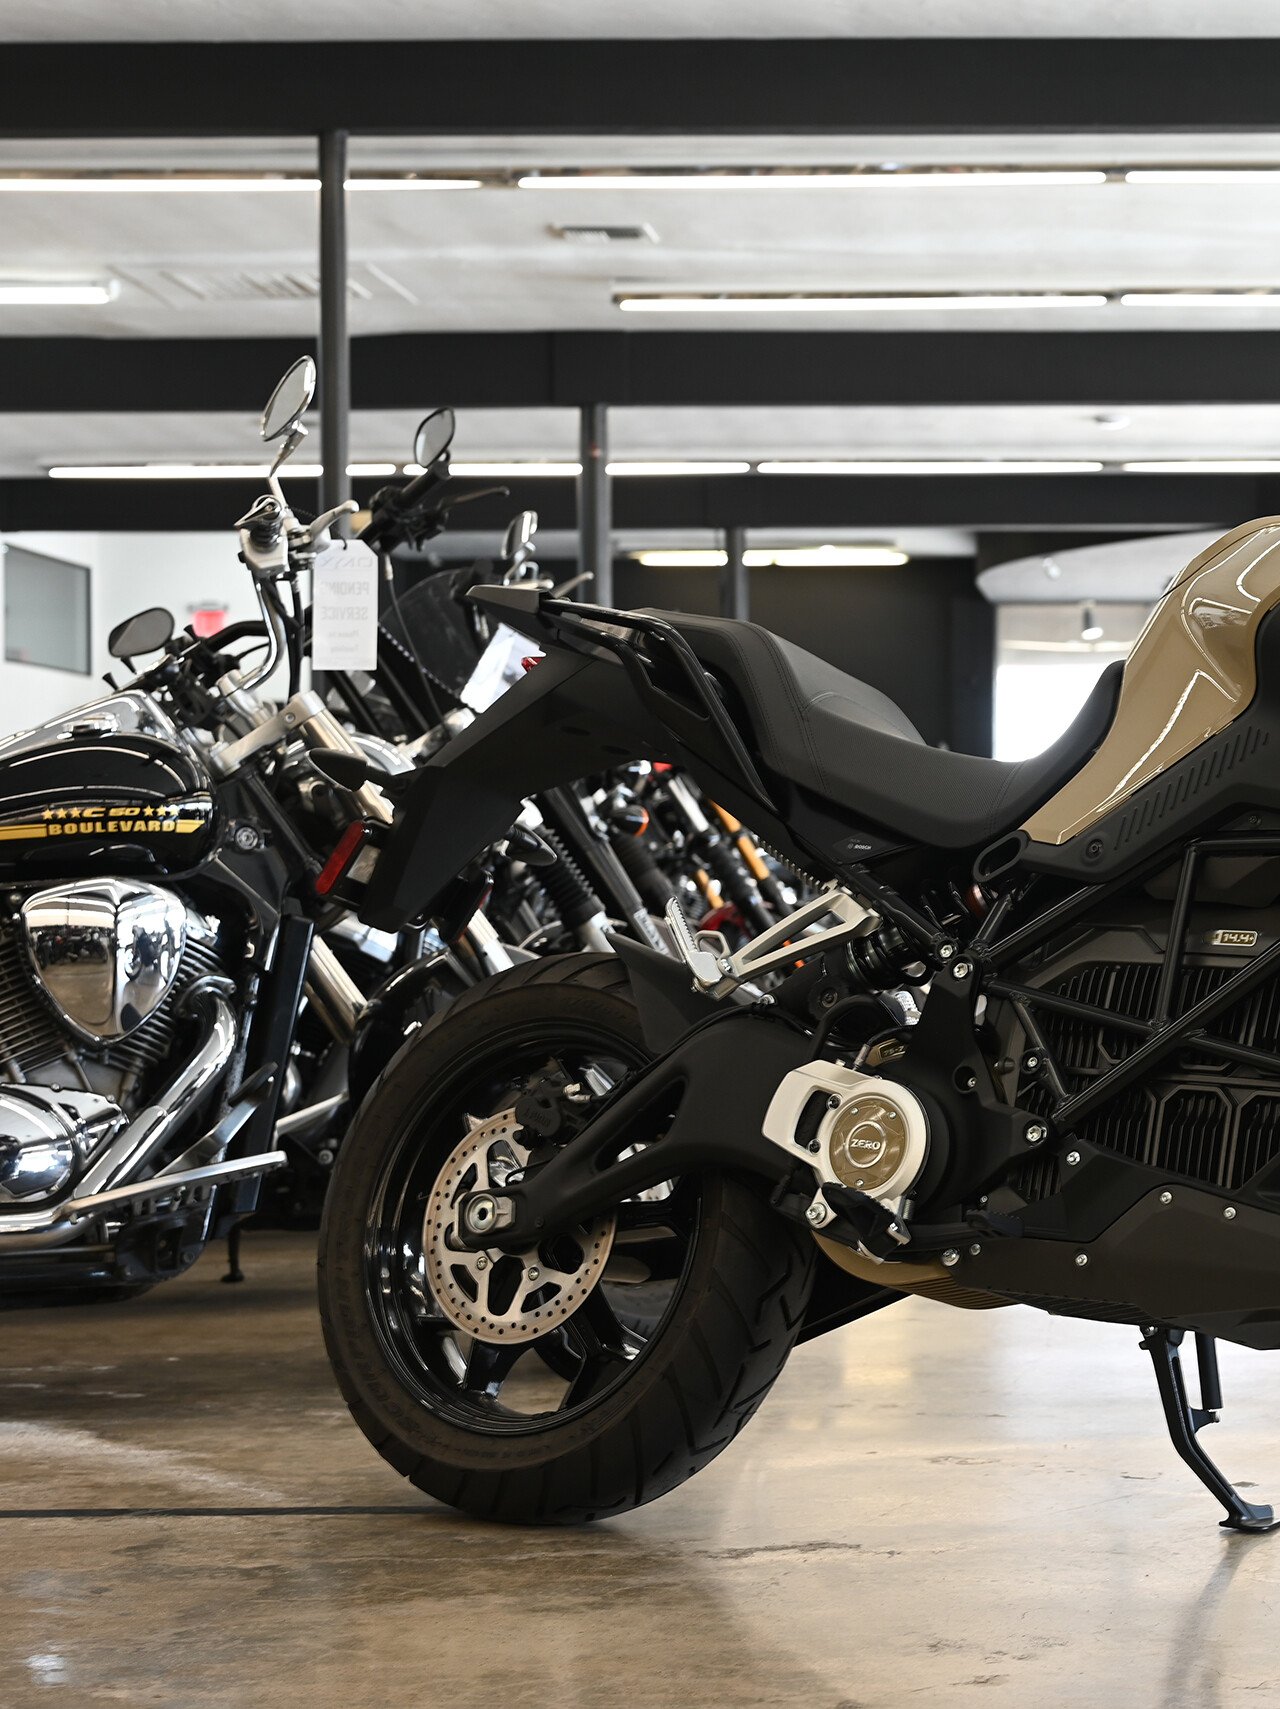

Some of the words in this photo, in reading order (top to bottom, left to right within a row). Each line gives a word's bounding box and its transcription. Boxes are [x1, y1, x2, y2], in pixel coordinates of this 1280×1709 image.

[82, 807, 106, 818] C
[108, 807, 141, 817] 50
[48, 820, 176, 836] BOULEVARD
[850, 1138, 881, 1150] ZERO
